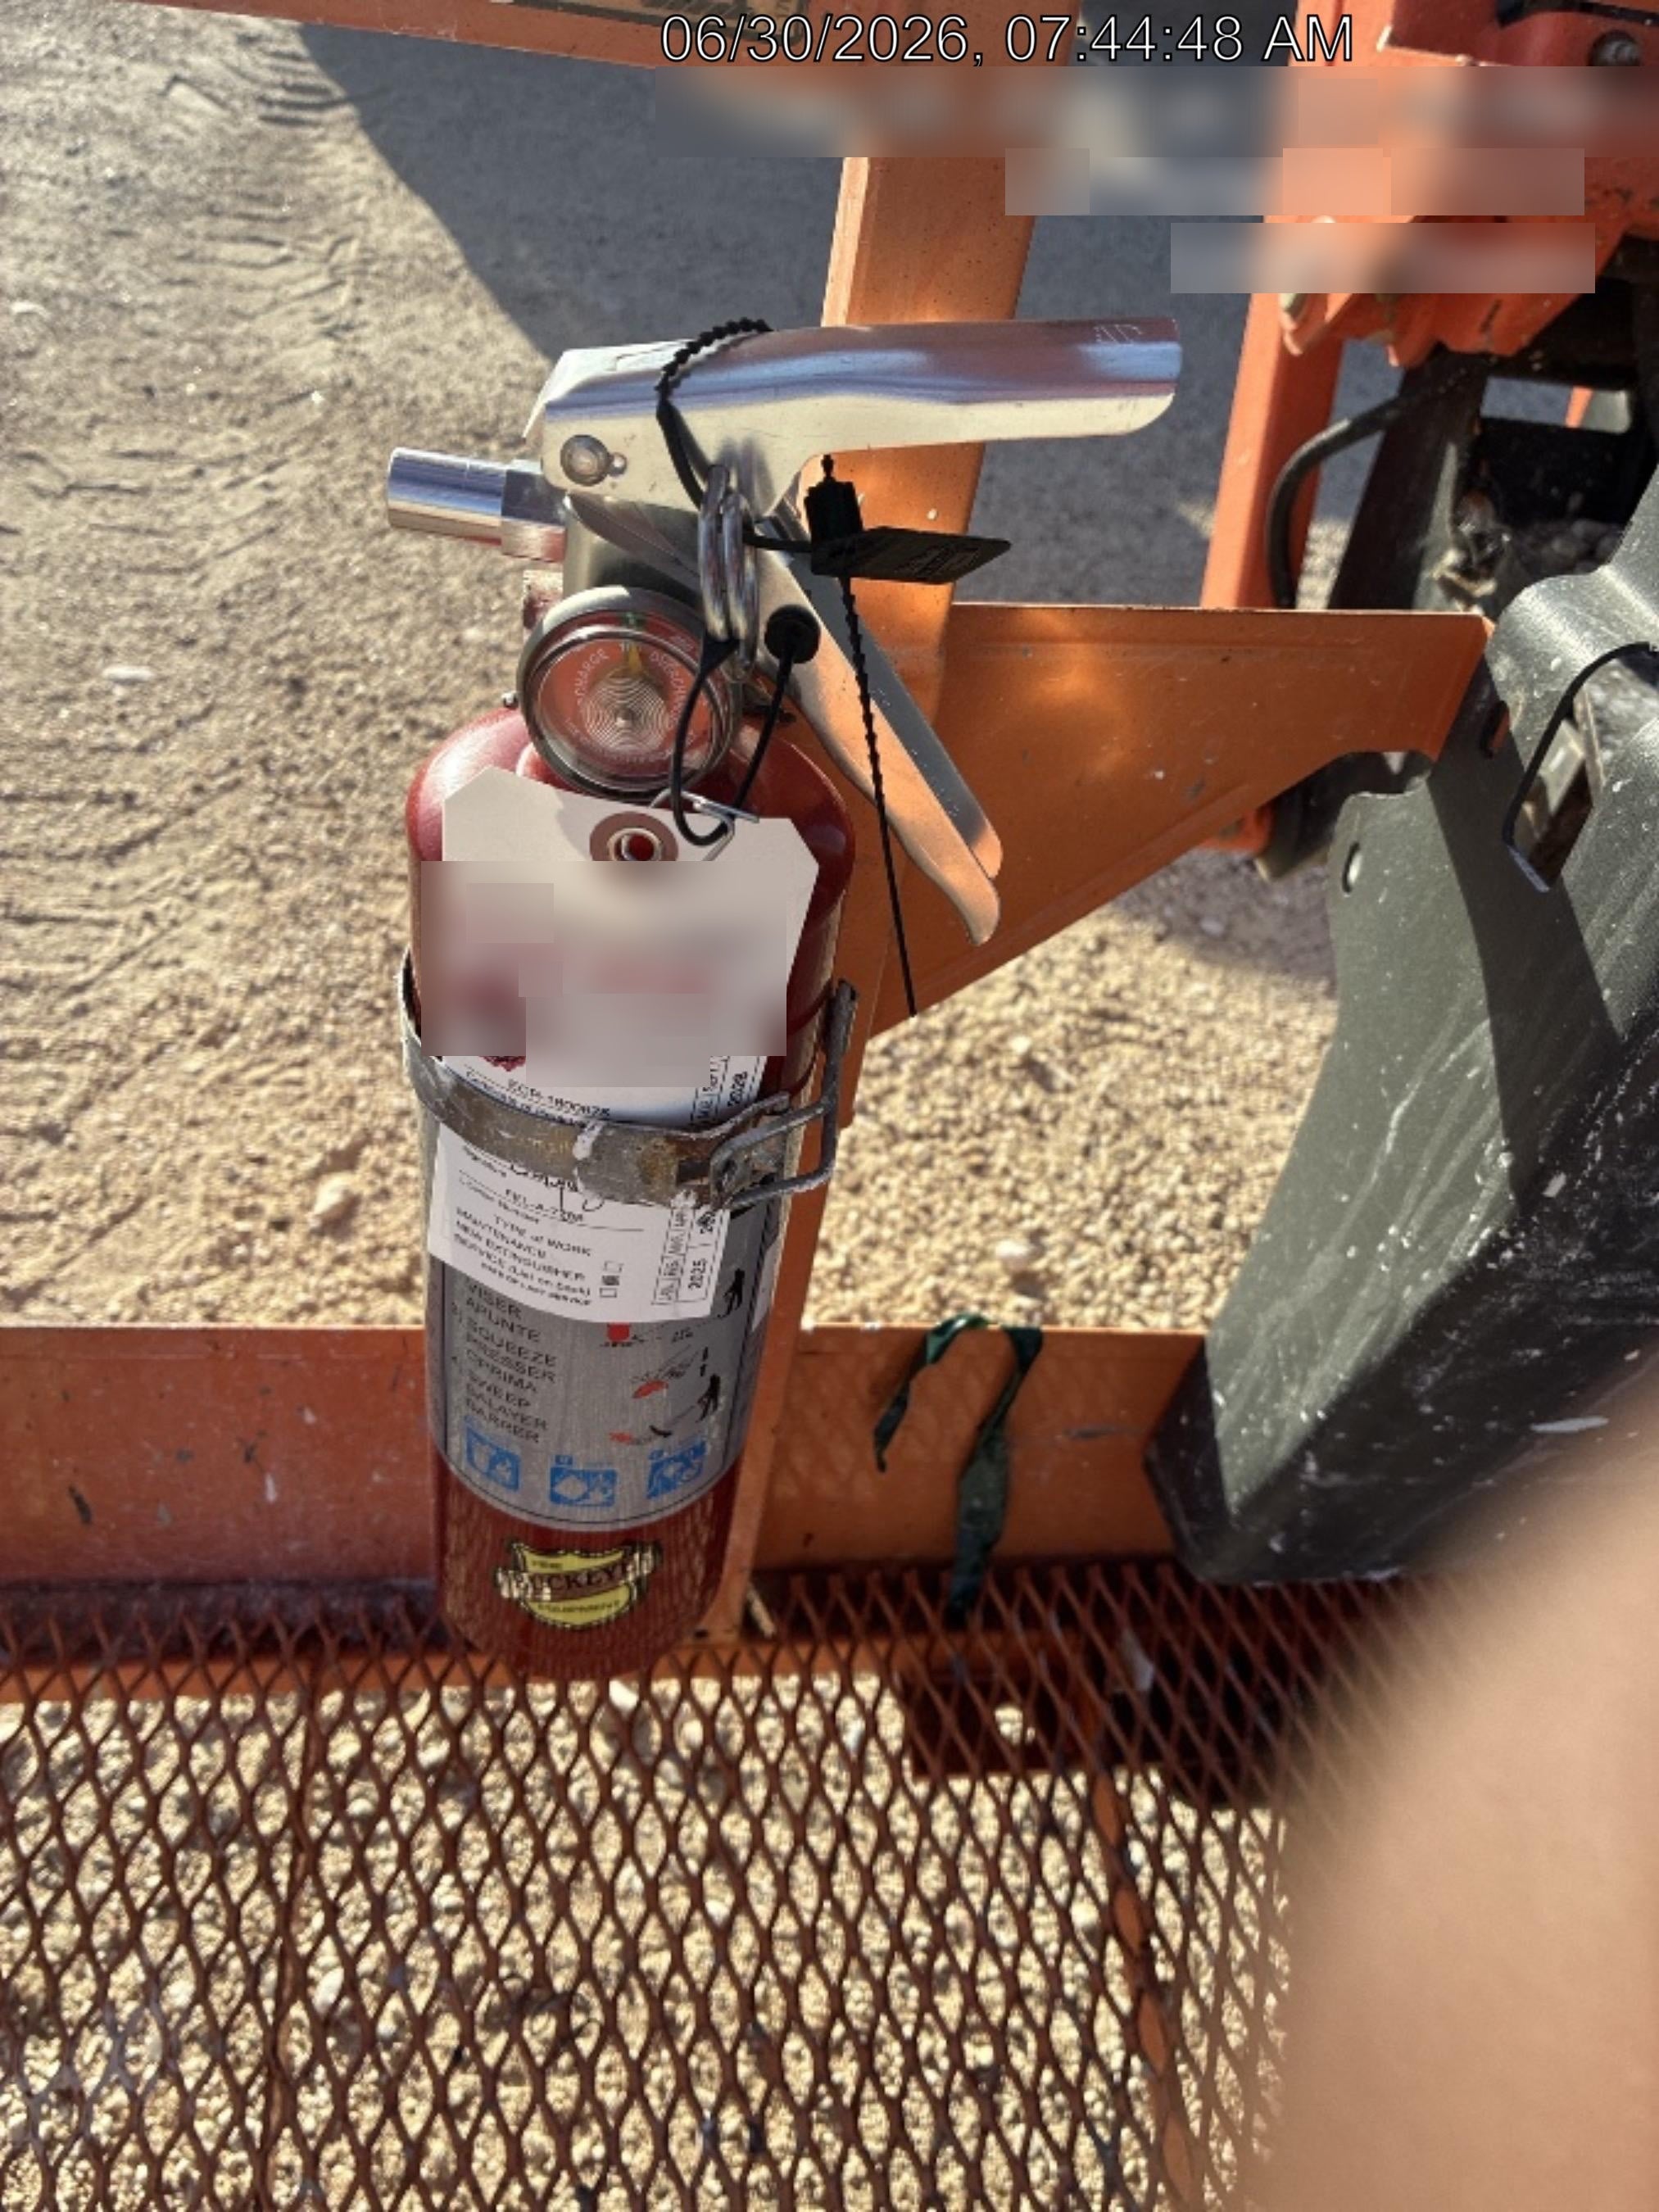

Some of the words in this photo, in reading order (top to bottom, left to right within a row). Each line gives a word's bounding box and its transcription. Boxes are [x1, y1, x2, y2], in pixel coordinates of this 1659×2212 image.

[687, 1258, 708, 1290] 2025
[465, 1296, 542, 1344] APUNTE
[466, 1317, 558, 1368] SQUEEZE
